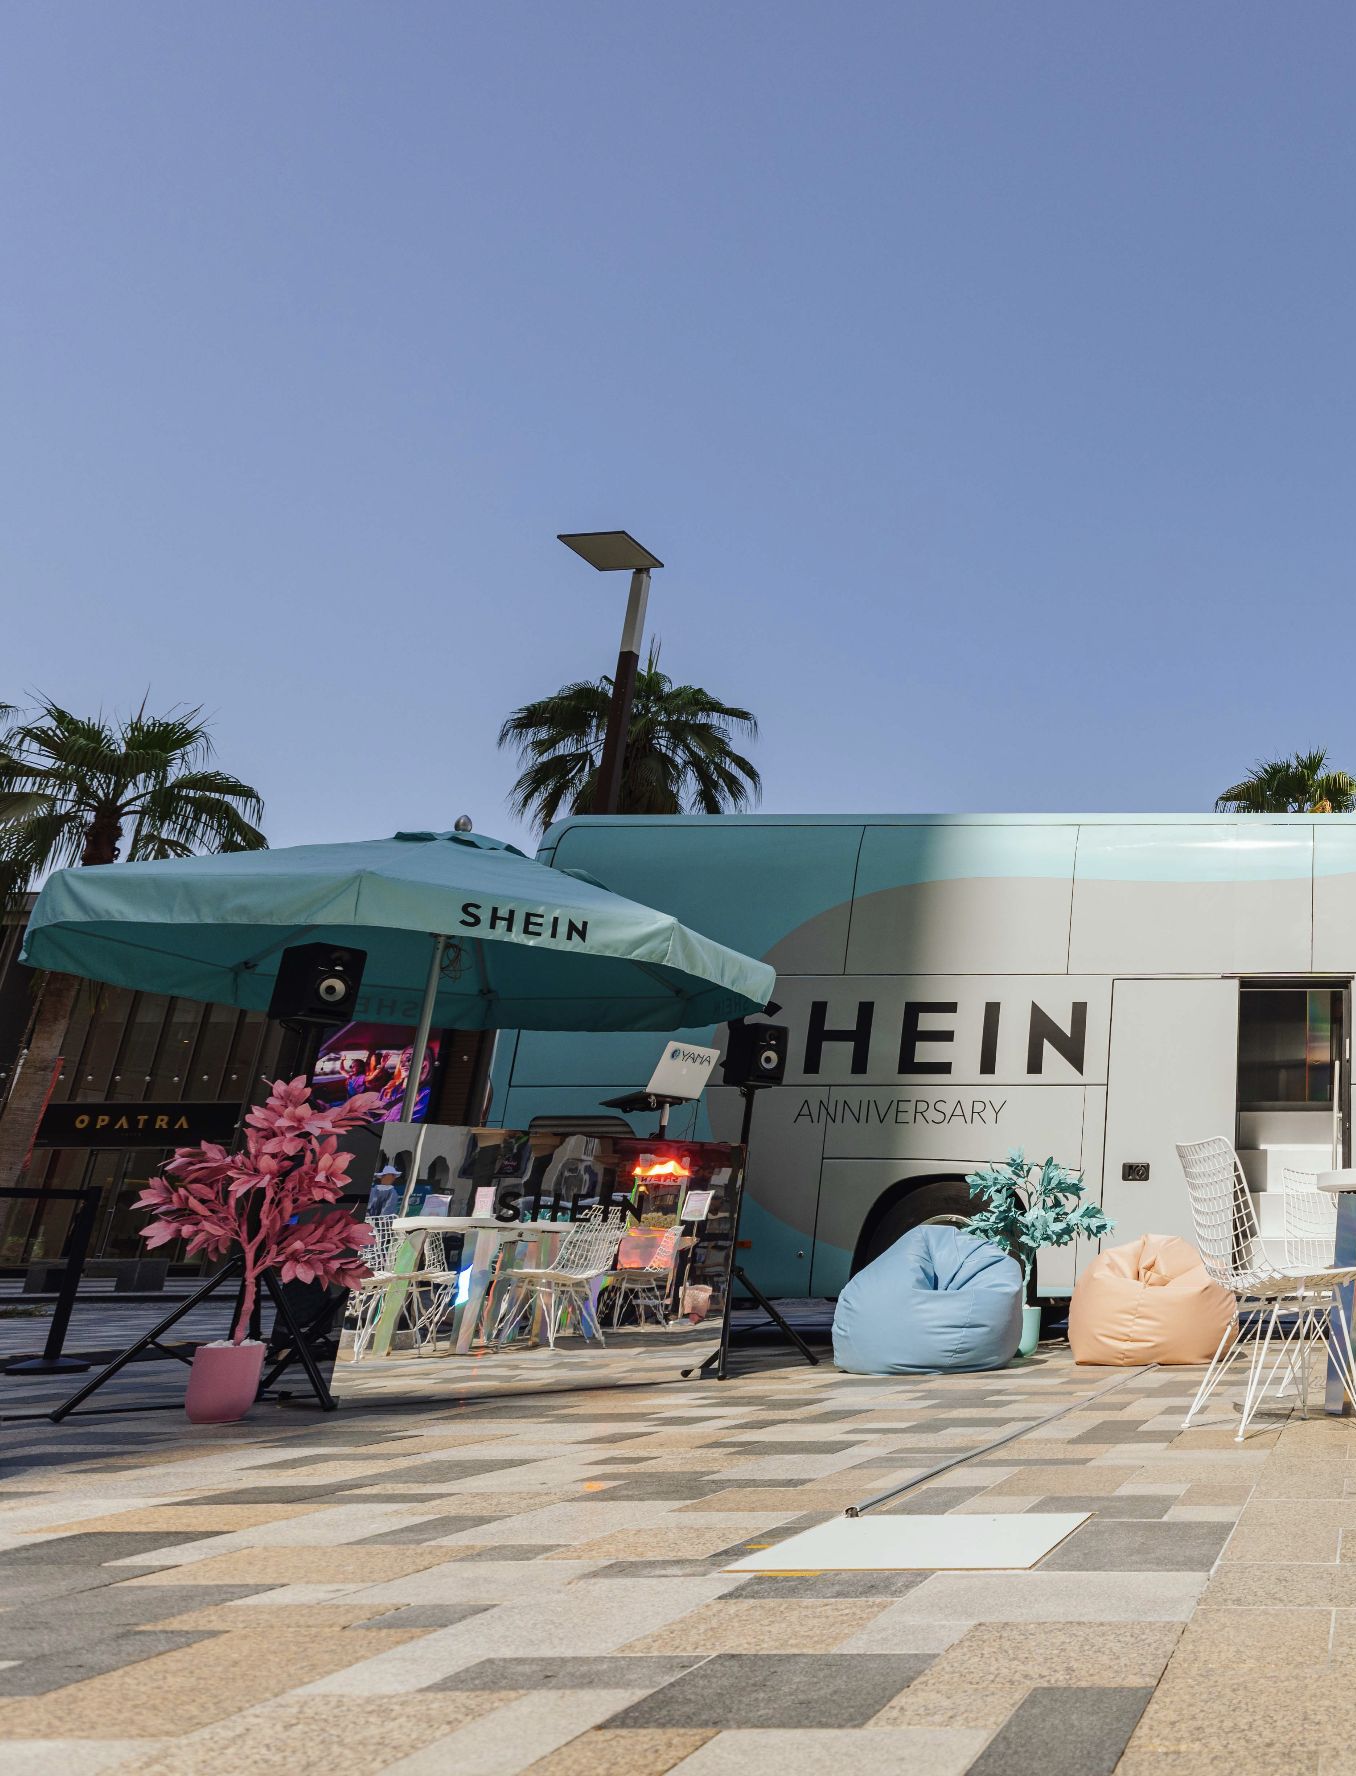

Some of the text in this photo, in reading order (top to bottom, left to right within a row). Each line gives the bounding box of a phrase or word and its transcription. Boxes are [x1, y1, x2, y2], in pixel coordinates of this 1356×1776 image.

[458, 902, 589, 943] SHEIN
[719, 1000, 1088, 1077] HEIN
[74, 1114, 190, 1129] OPATRA
[793, 1099, 1007, 1125] ANNIVERSARY
[495, 1191, 644, 1223] SHEIN
